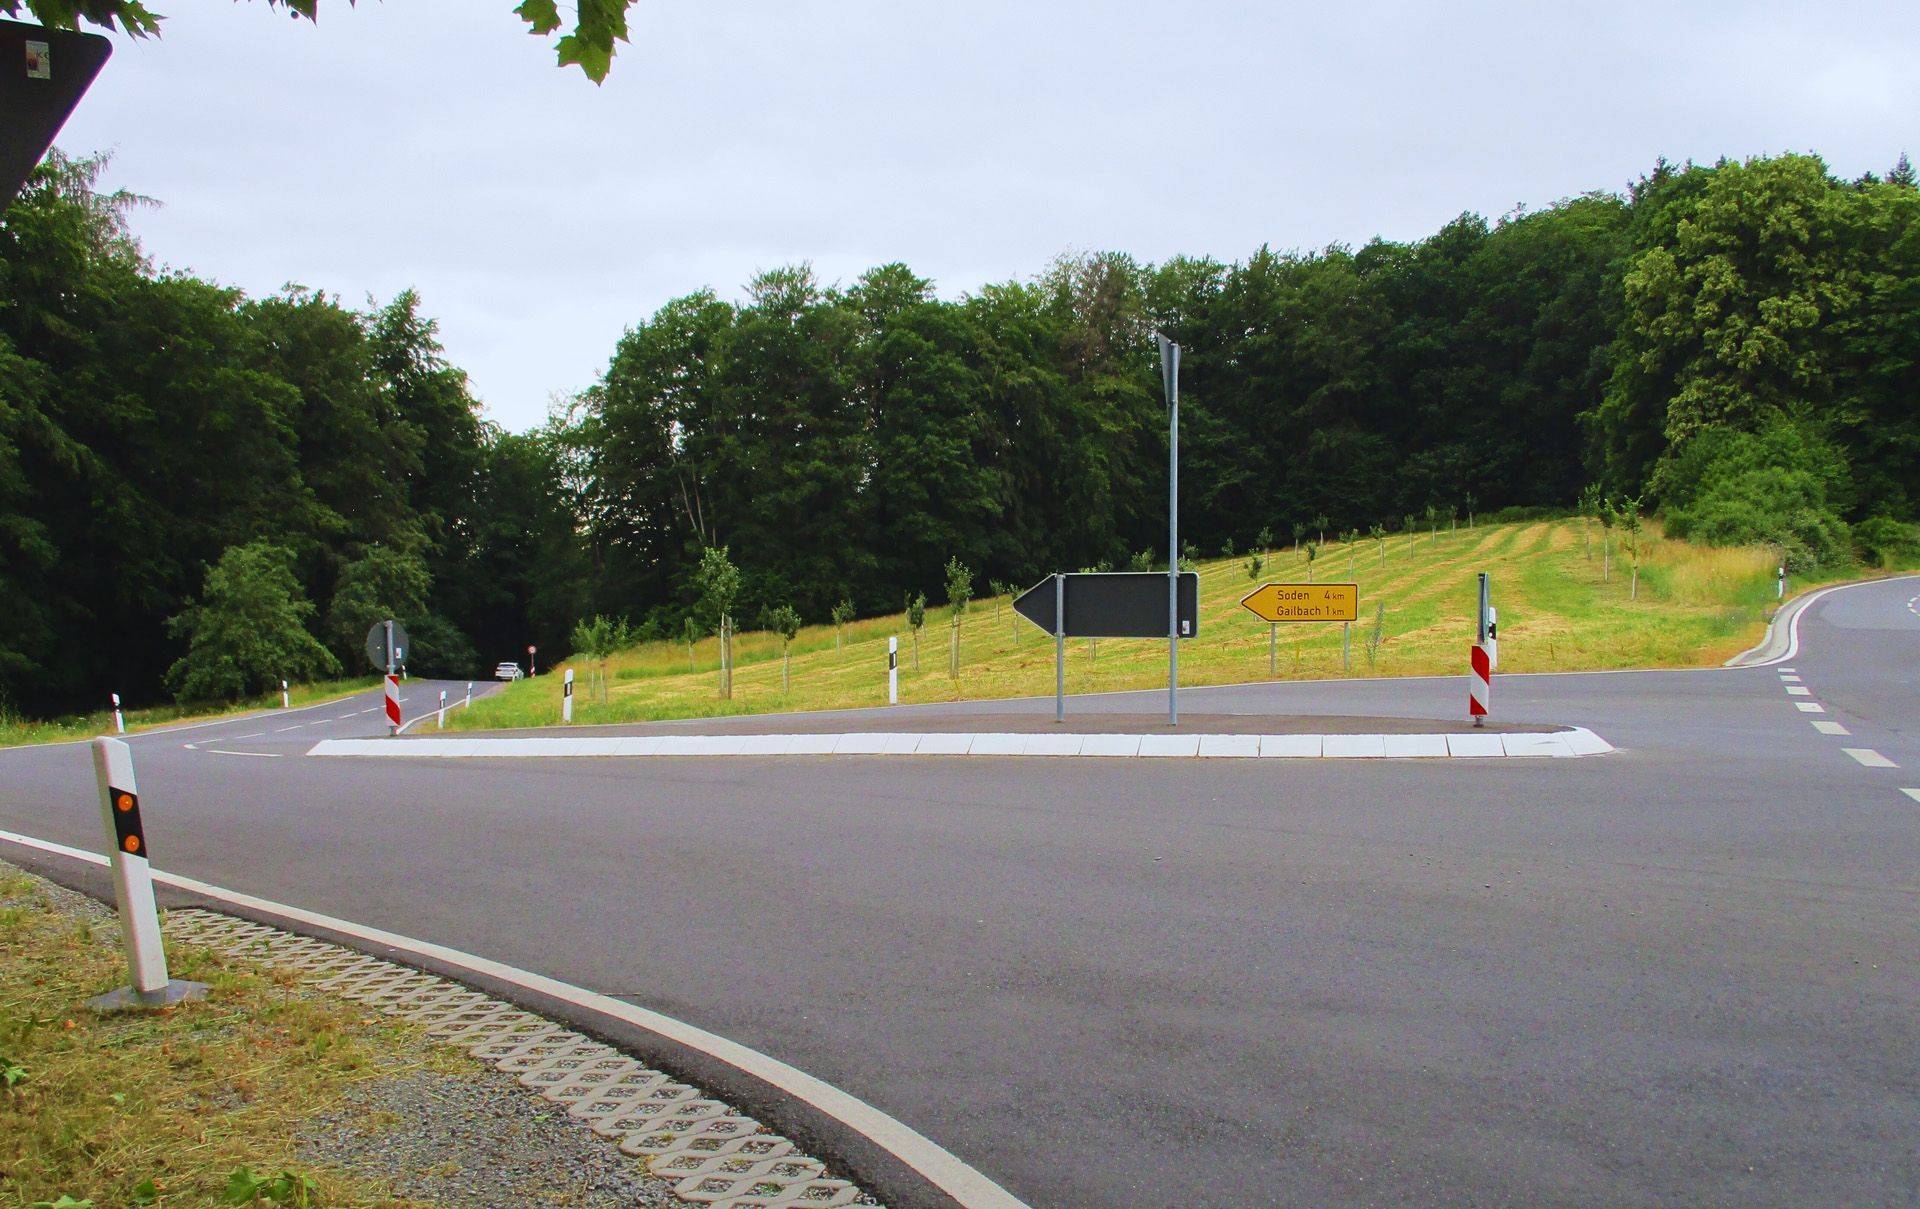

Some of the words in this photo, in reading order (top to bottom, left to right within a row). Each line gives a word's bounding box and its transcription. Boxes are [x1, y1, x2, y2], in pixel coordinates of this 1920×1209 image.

[1277, 590, 1310, 600] Soden
[1324, 590, 1330, 600] 4
[1332, 592, 1345, 600] km
[1277, 606, 1321, 616] Gailbach
[1325, 606, 1329, 616] 1
[1332, 608, 1345, 616] km
